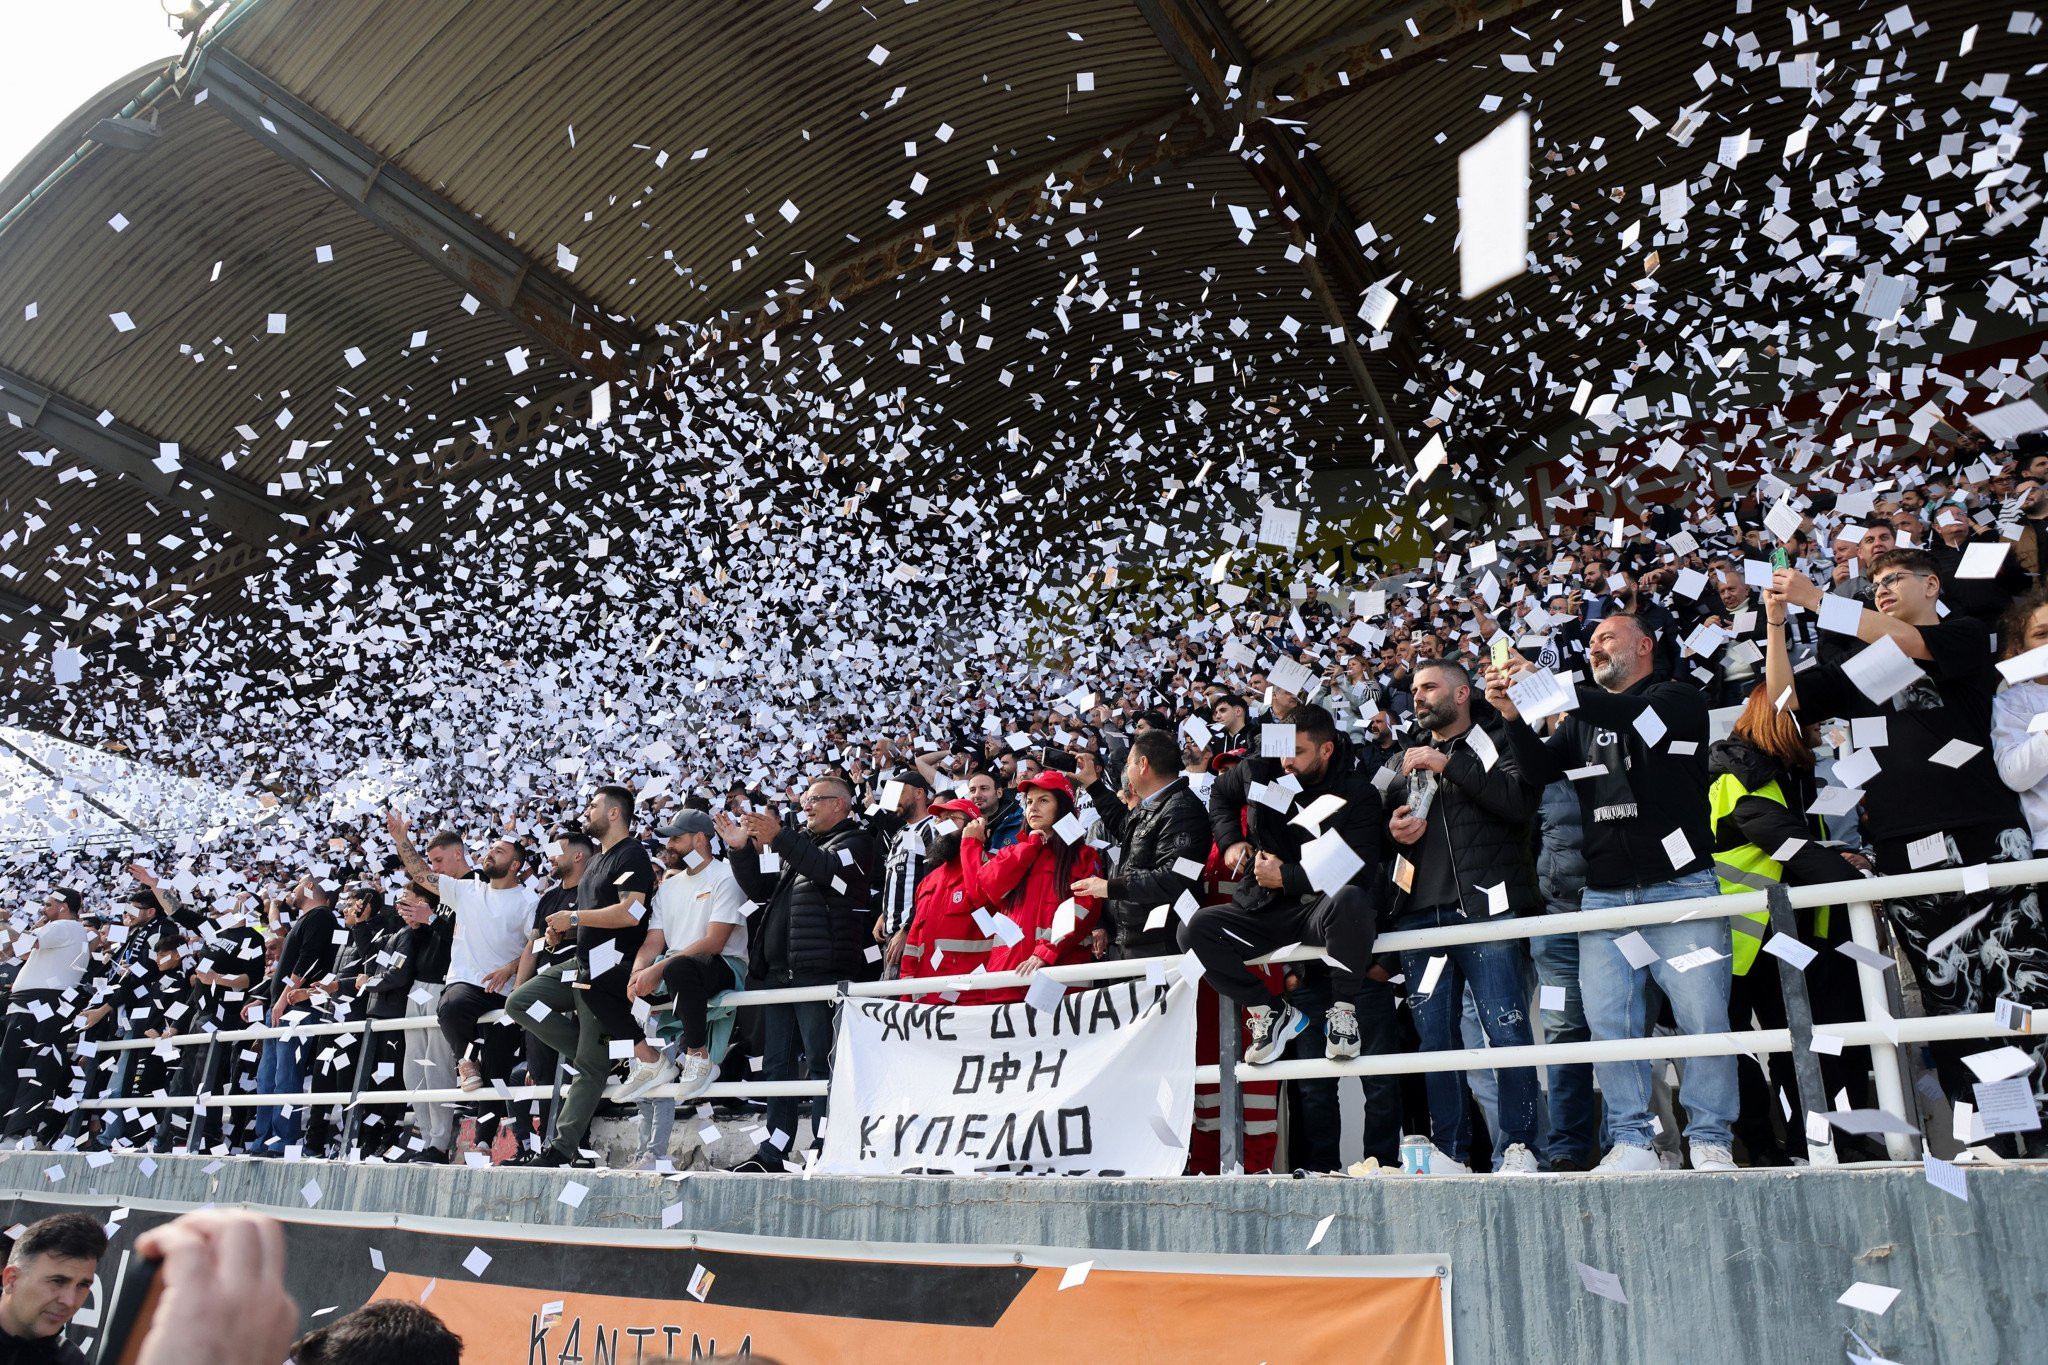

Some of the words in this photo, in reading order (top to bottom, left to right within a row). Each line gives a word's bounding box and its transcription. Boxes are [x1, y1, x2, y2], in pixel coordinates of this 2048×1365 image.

[129, 930, 147, 958] THIS
[952, 1048, 1067, 1094] ΟΦΗ
[860, 1105, 1092, 1161] ΚΥΠΕΛΛΟ
